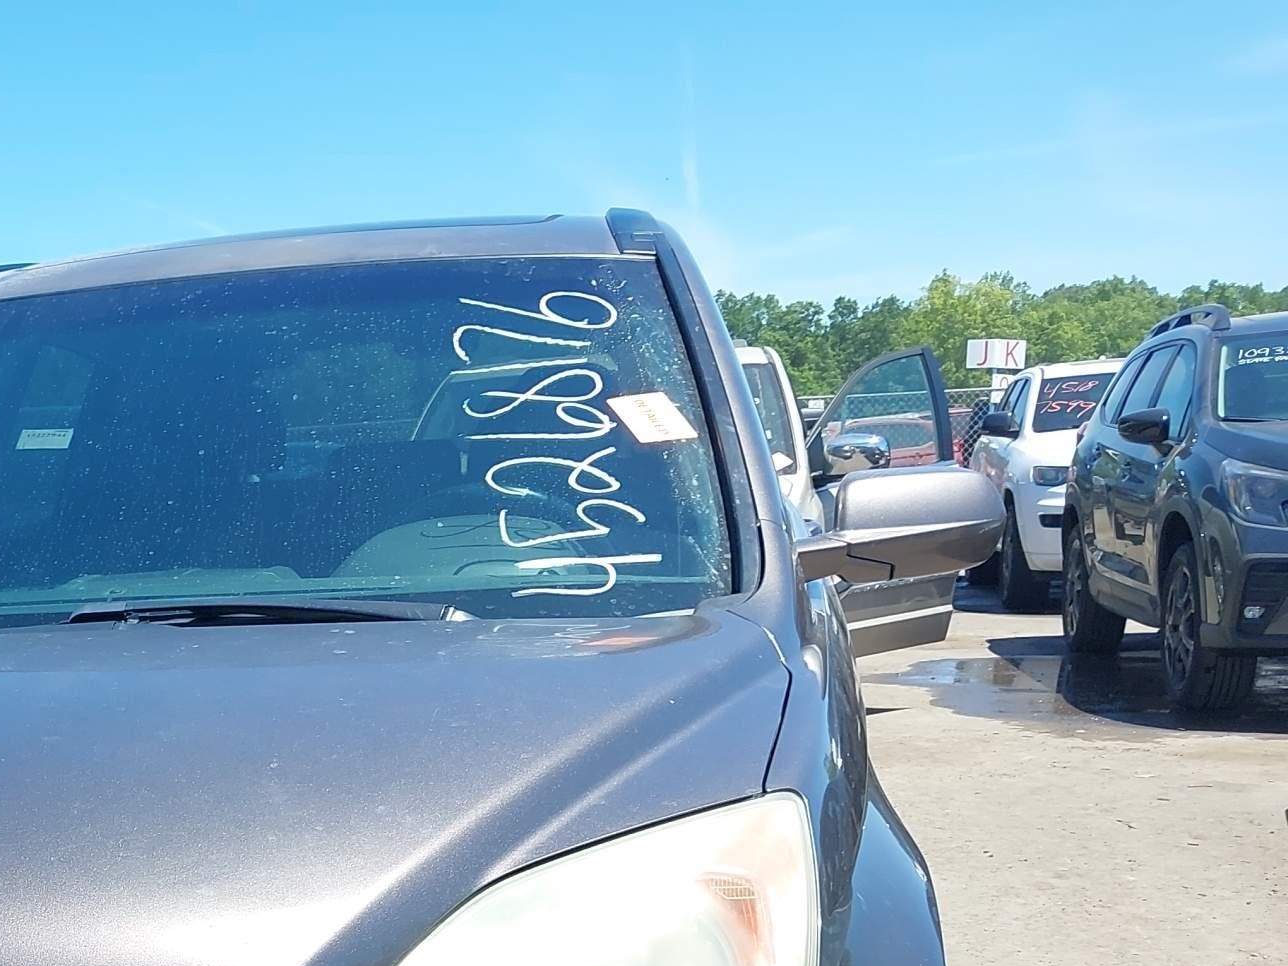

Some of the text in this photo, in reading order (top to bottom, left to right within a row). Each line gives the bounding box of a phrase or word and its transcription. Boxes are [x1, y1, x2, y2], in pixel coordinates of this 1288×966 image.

[975, 340, 1020, 368] J K
[1043, 379, 1100, 399] 4518
[450, 290, 661, 598] 45268176
